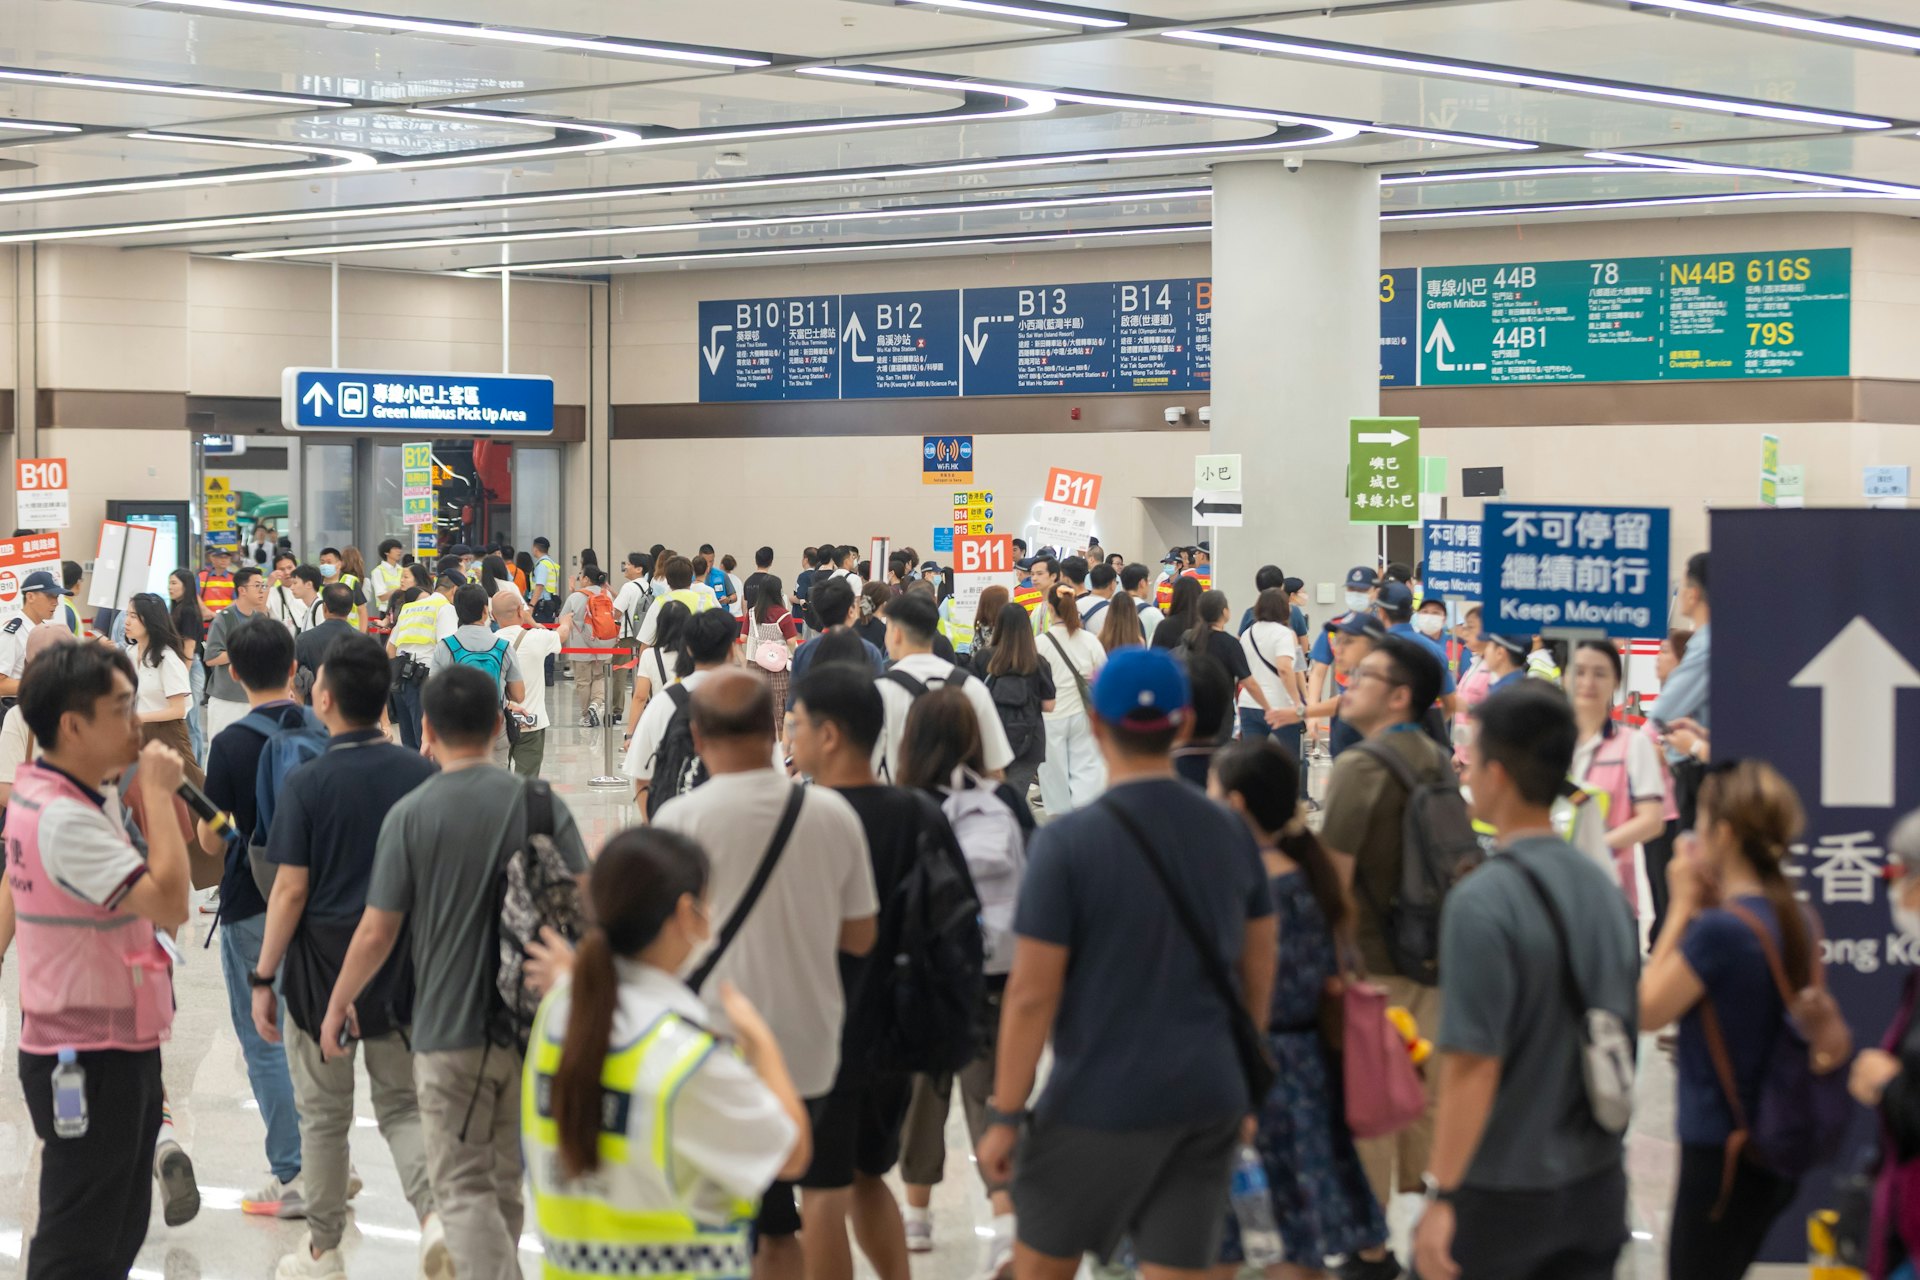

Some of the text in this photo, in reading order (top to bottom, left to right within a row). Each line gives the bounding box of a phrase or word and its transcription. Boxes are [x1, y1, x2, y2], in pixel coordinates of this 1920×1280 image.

[1493, 267, 1536, 289] 44B
[1590, 263, 1619, 285] 78
[1670, 261, 1735, 285] N44B
[1747, 258, 1811, 283] 616S
[1121, 284, 1171, 312] B14
[1427, 278, 1487, 297] 專線小巴
[789, 301, 828, 326] B11
[1019, 288, 1066, 316] B13
[1427, 299, 1487, 309] Green Minibus
[736, 302, 779, 328] B10
[877, 302, 922, 329] B12
[1492, 326, 1546, 348] 44B1
[1747, 322, 1794, 346] 79S
[1670, 360, 1703, 368] Overnight
[373, 383, 479, 406] 專線小巴上客區
[373, 406, 526, 424] Green Minibus Pick Up Area
[405, 447, 430, 467] B12
[1369, 457, 1400, 470] 嶼巴
[21, 463, 62, 488] B10
[1202, 466, 1232, 481] 小巴
[1369, 476, 1400, 489] 城巴
[954, 494, 967, 504] B13
[1052, 473, 1094, 506] B11
[1354, 494, 1415, 509] 專線小巴
[954, 510, 967, 520] B14
[954, 525, 967, 535] B15
[1428, 524, 1482, 547] 不可停留
[1502, 510, 1651, 550] 不可停留
[962, 540, 1004, 571] B11
[1428, 551, 1482, 574] 繼續前行
[1501, 554, 1650, 594] 繼續前行
[1428, 578, 1482, 594] Keep Moving
[1500, 598, 1649, 627] Keep Moving
[1818, 934, 1920, 974] ong Ko
